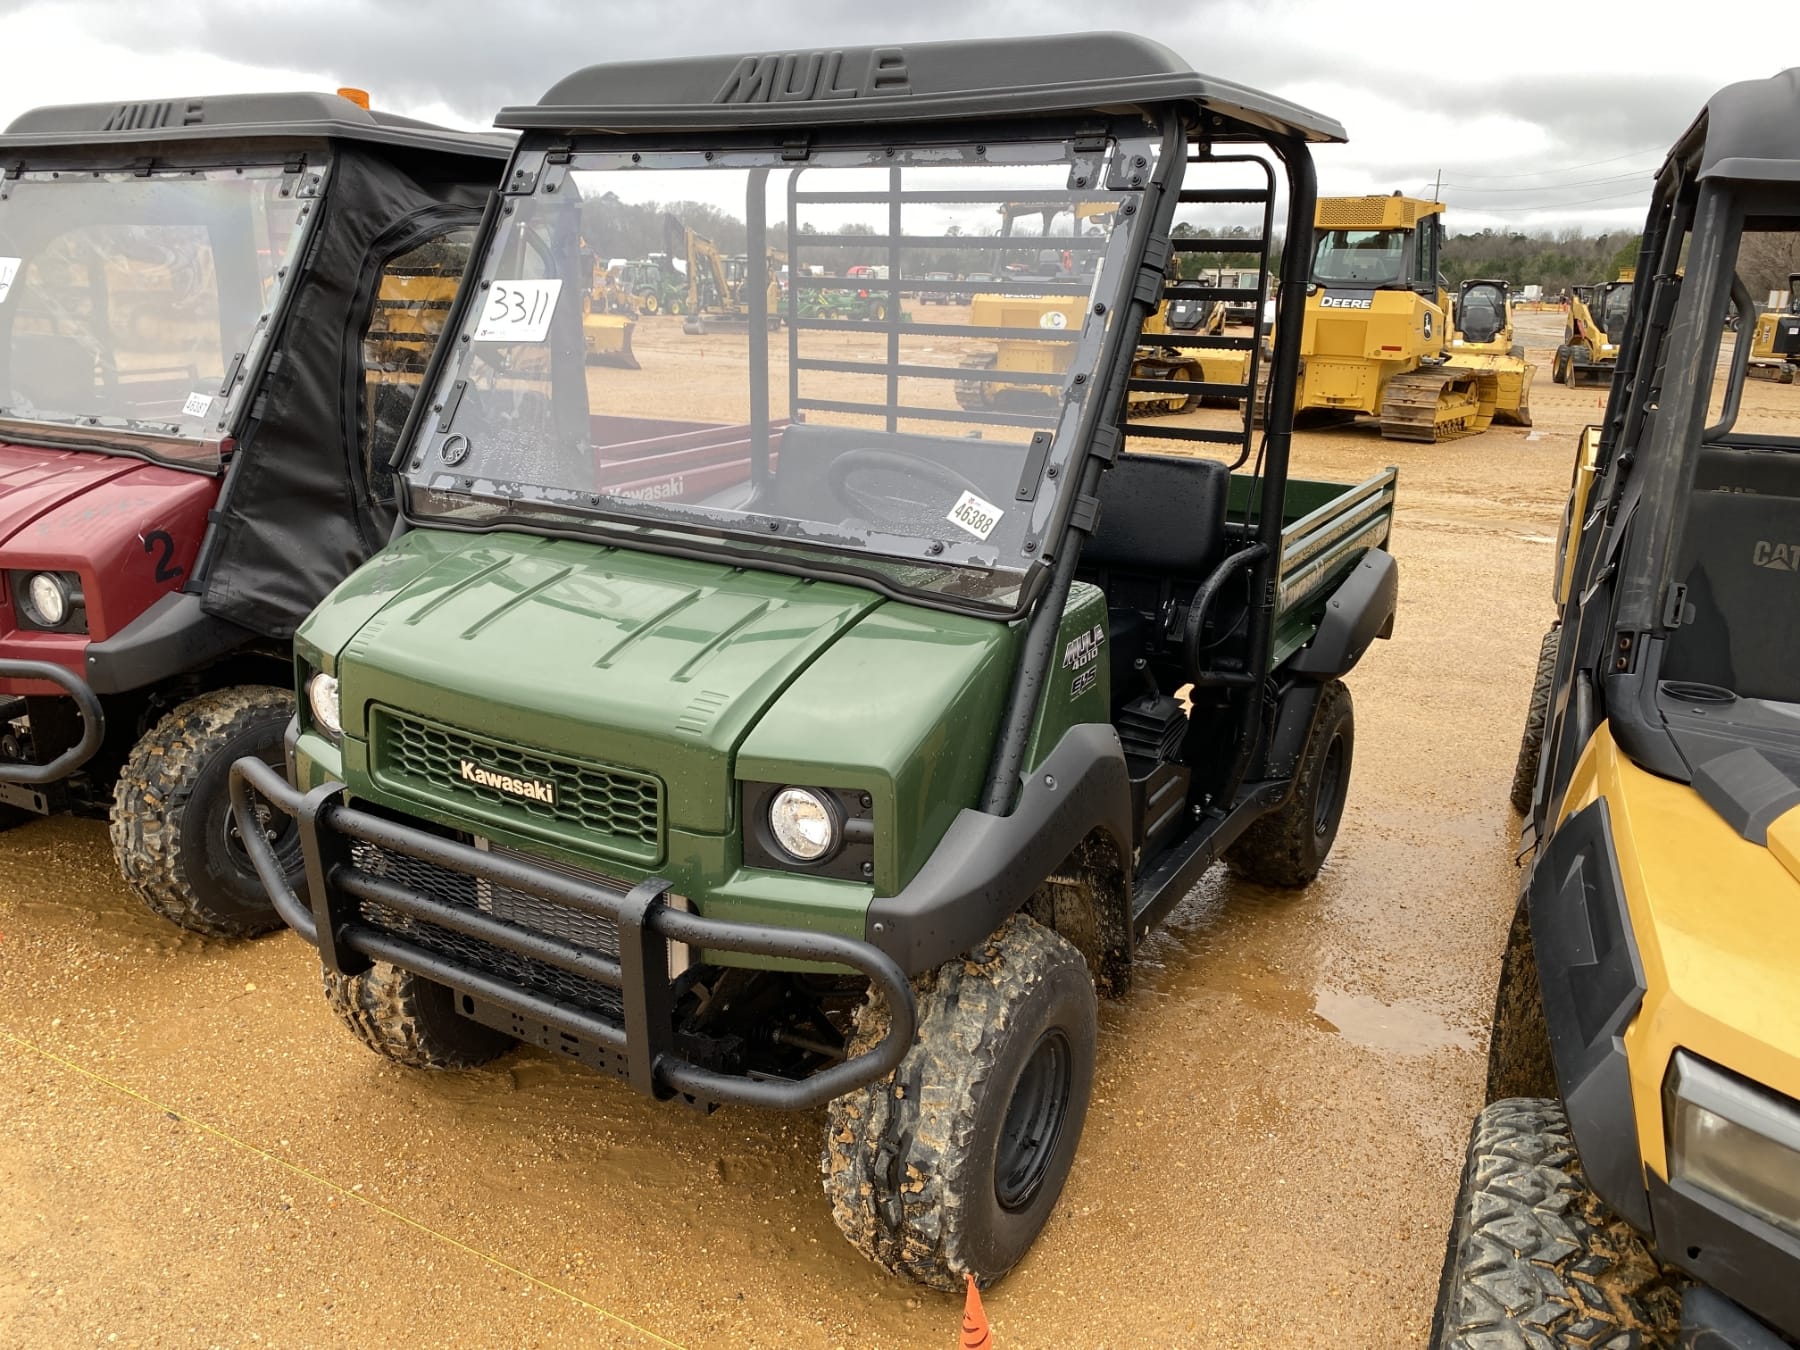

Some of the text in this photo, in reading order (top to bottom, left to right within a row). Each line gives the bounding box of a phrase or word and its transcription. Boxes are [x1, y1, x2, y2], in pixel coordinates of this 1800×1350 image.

[712, 48, 913, 104] MULE
[102, 97, 205, 131] MULE
[489, 286, 549, 326] 3311
[1320, 296, 1372, 309] DEERE
[954, 503, 994, 533] 46388
[145, 529, 184, 584] 2
[1753, 541, 1800, 571] CAT
[1062, 623, 1106, 669] MULE
[1072, 646, 1099, 671] 4010
[460, 759, 554, 804] Kawasaki
